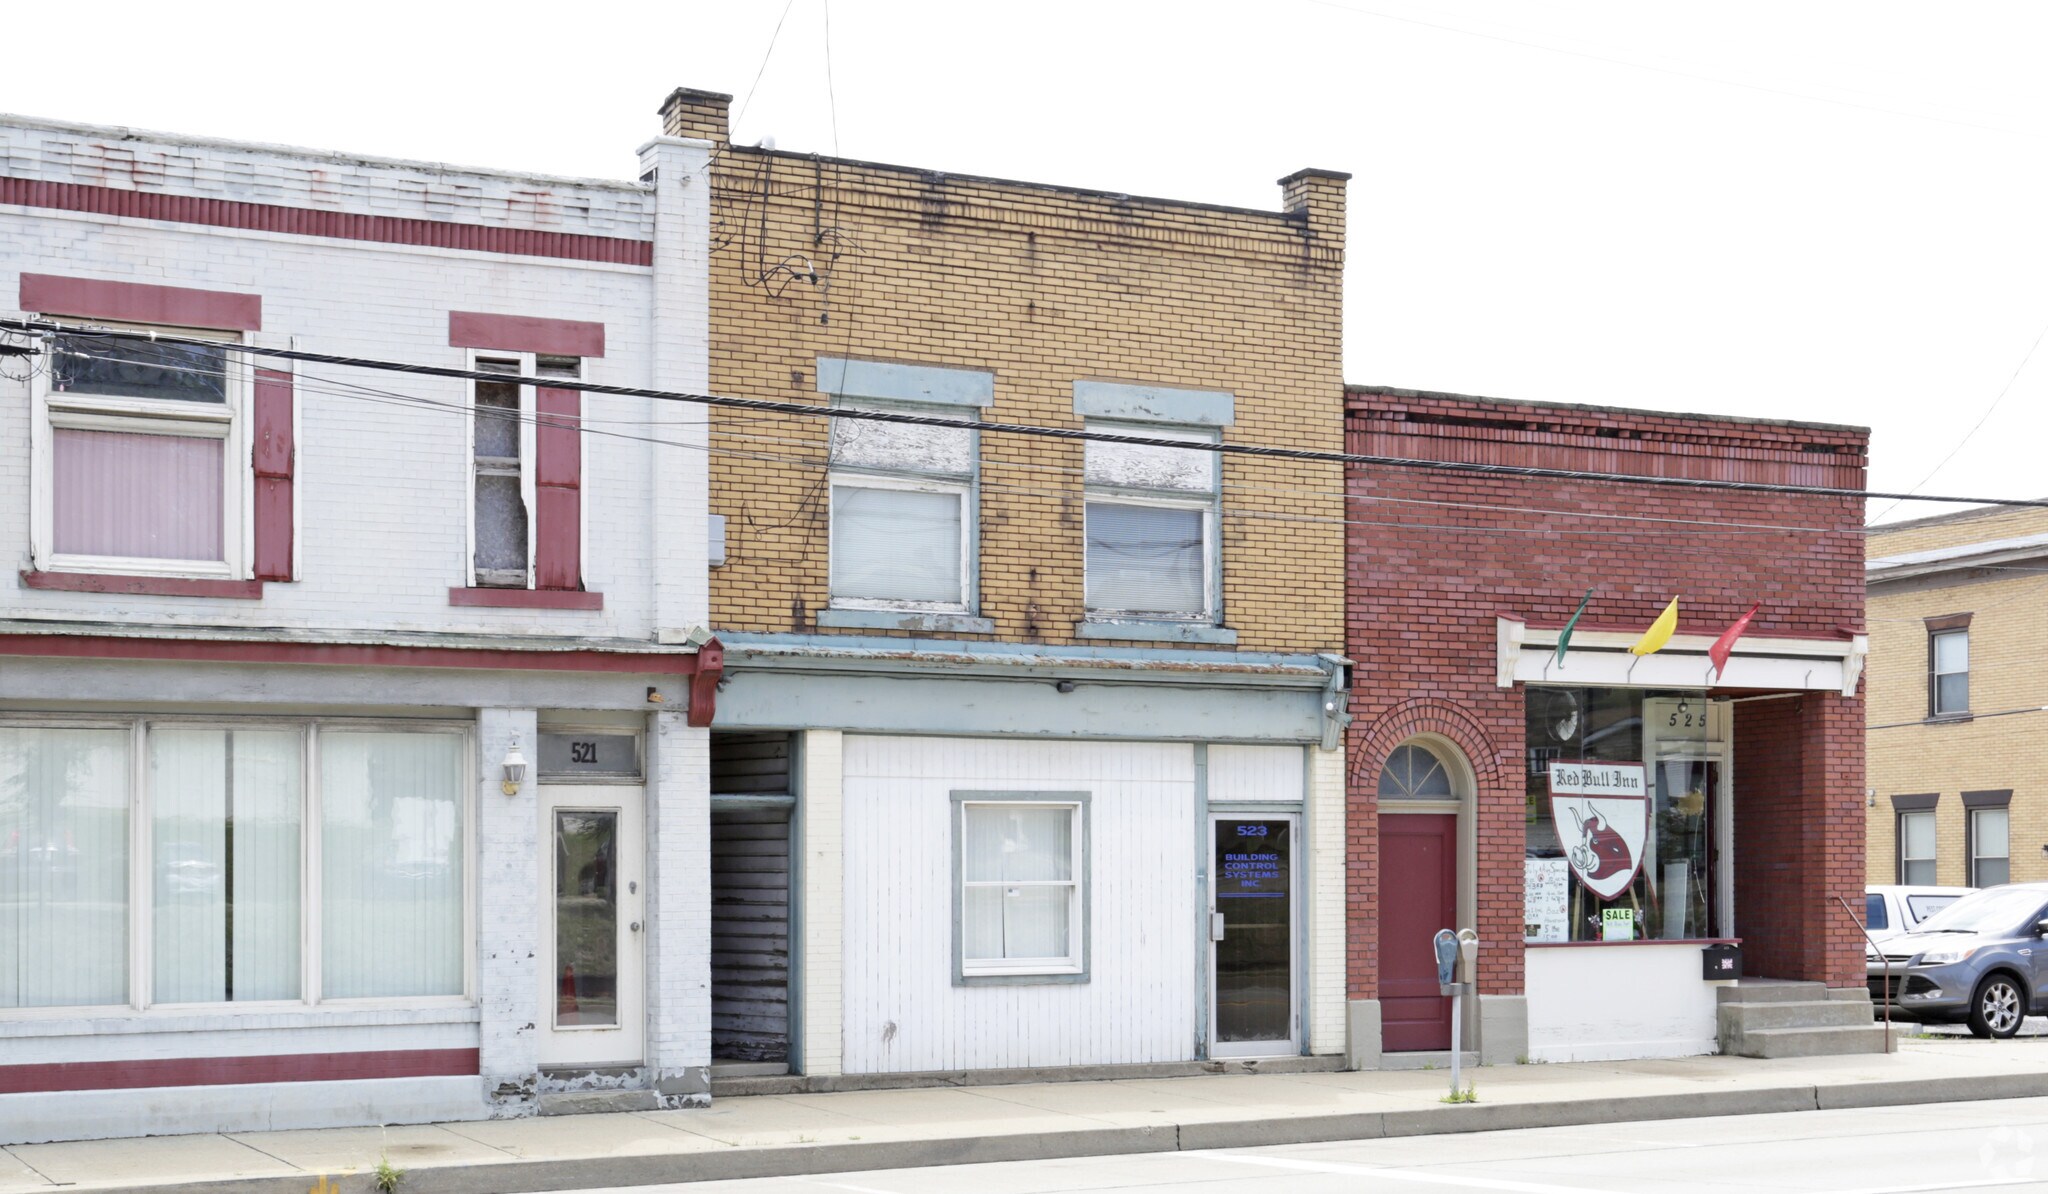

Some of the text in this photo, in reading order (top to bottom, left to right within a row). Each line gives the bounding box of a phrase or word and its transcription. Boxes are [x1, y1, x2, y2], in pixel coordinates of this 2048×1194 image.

[1669, 712, 1706, 727] 525
[571, 742, 598, 763] 521
[1555, 768, 1638, 789] Red Bull Inn
[1237, 825, 1268, 836] 523
[1225, 853, 1279, 861] BUILDING
[1225, 862, 1279, 870] CONTROL
[1225, 871, 1280, 879] SYSTEMS
[1605, 910, 1630, 920] SALE
